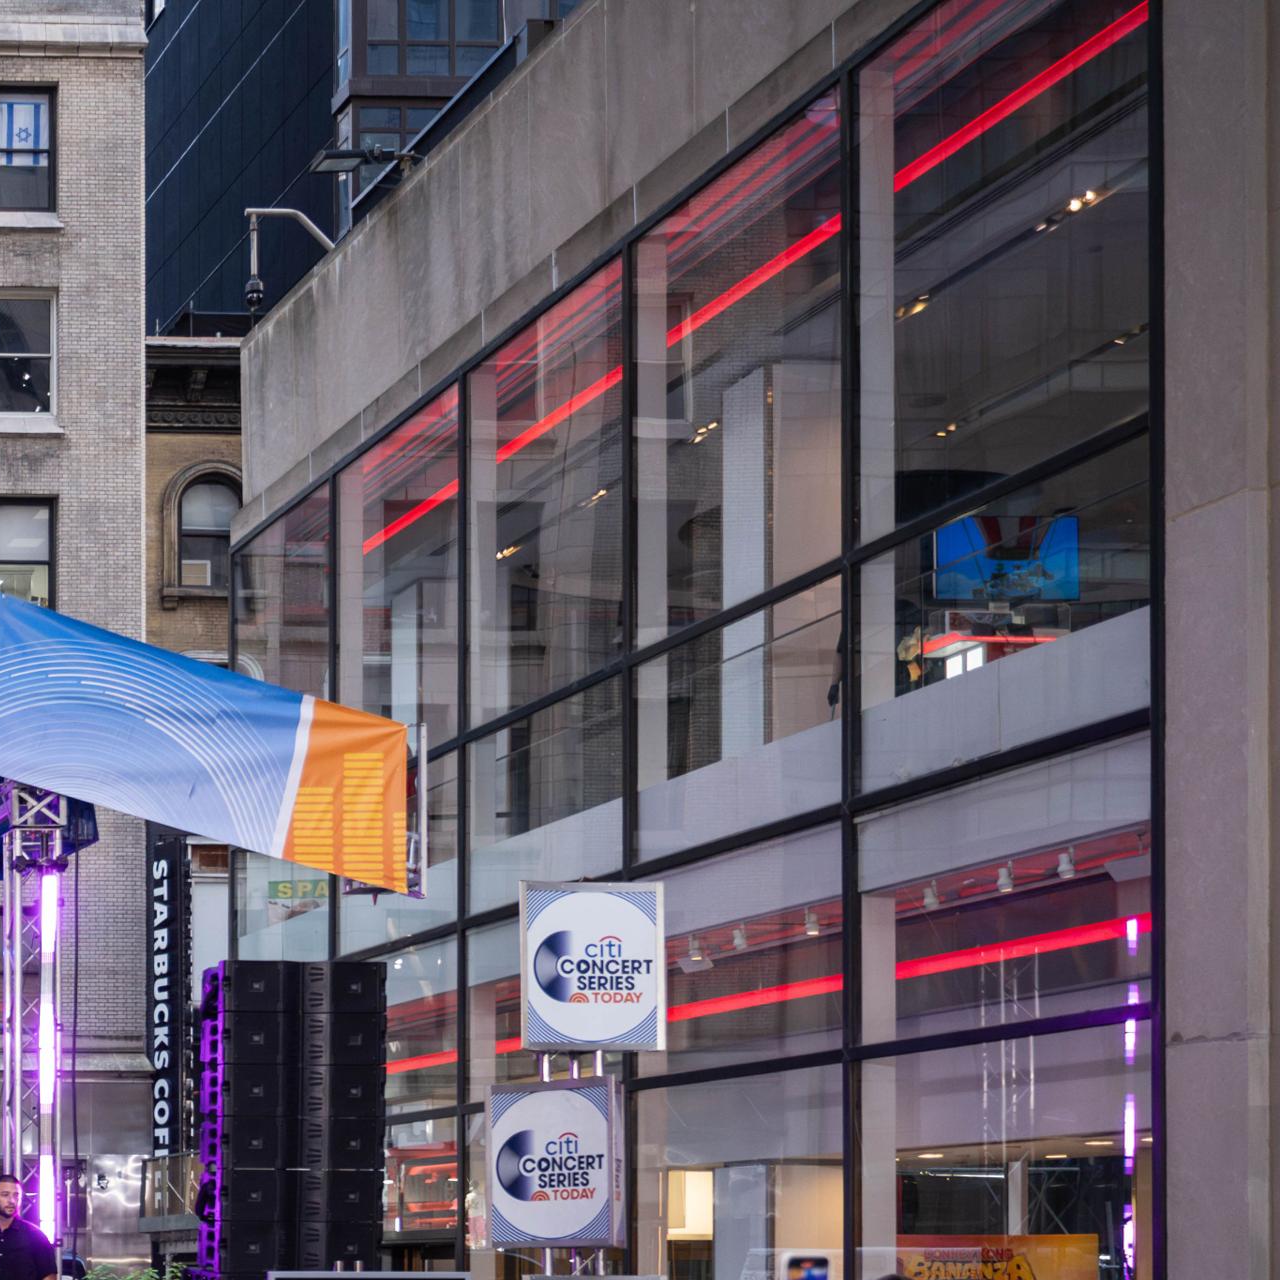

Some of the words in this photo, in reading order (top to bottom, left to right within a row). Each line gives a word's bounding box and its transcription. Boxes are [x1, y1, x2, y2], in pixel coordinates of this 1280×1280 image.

[277, 881, 329, 898] SPA
[585, 940, 622, 958] citi
[152, 859, 170, 1068] STARBUCKS
[560, 959, 653, 974] CONCERT
[577, 976, 635, 990] SERIES
[592, 992, 643, 1003] TODAY
[545, 1137, 578, 1156] citi
[522, 1154, 604, 1173] CONCERT
[538, 1172, 589, 1188] SERIES
[552, 1188, 596, 1200] TODAY
